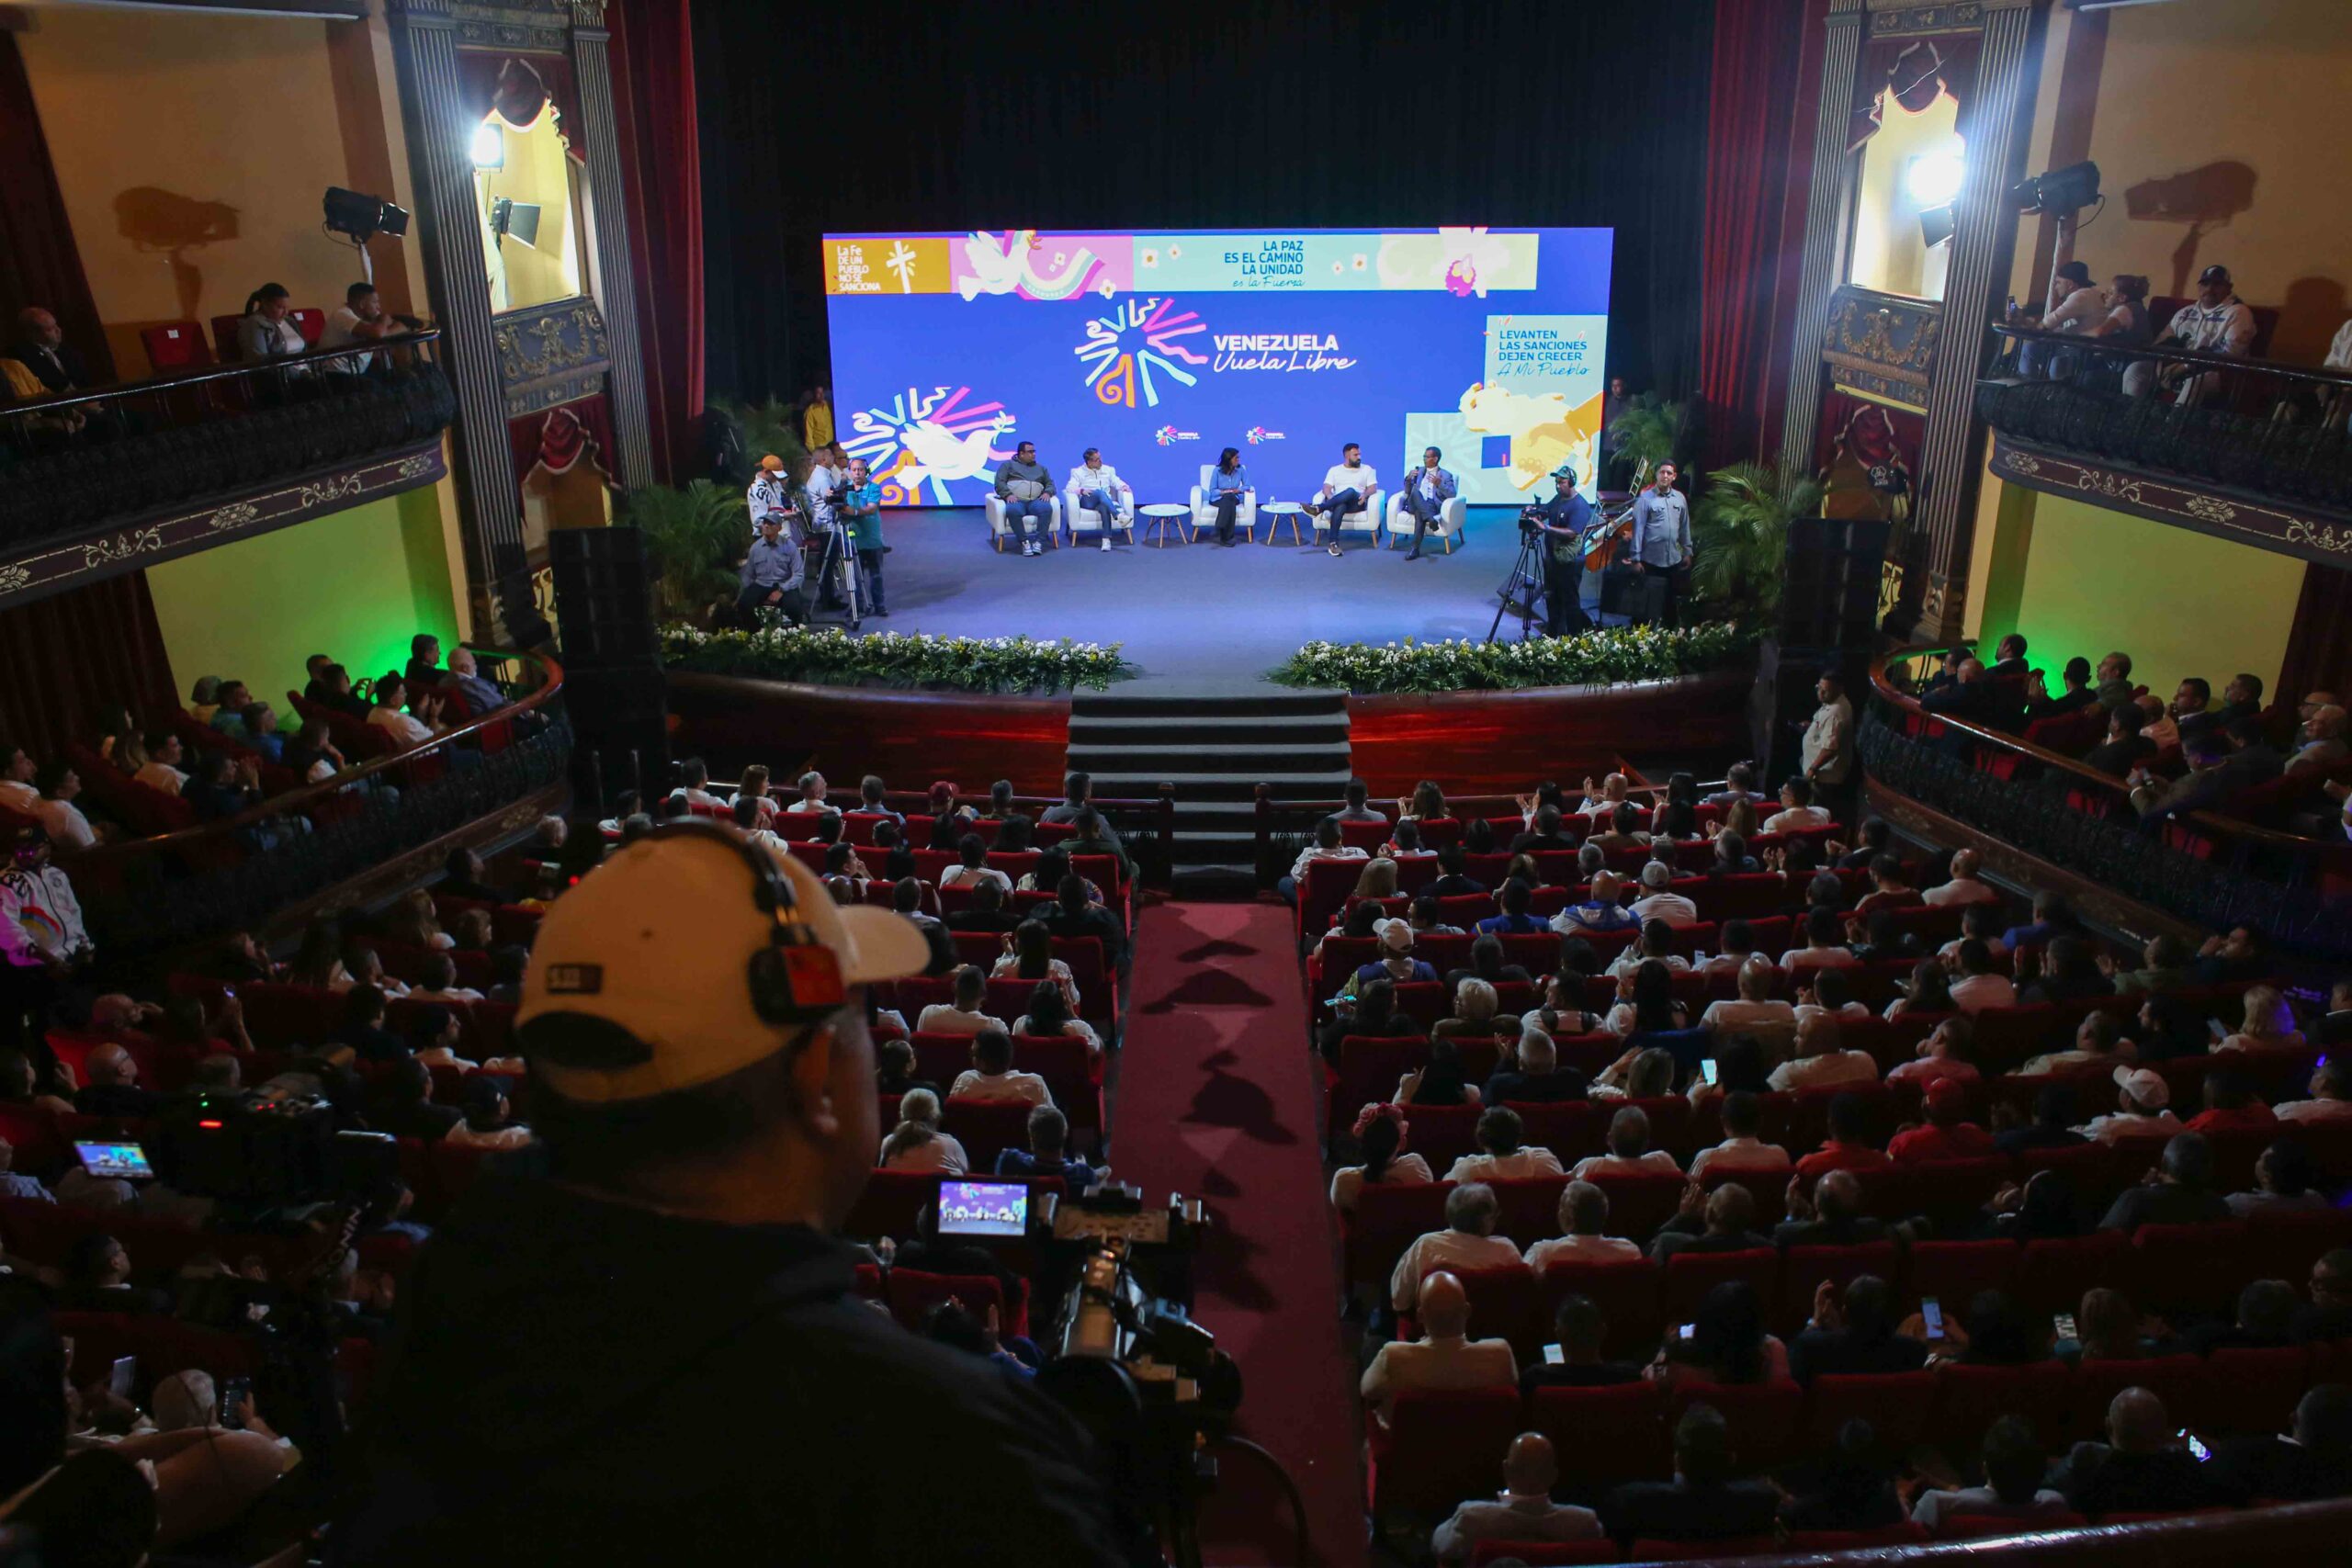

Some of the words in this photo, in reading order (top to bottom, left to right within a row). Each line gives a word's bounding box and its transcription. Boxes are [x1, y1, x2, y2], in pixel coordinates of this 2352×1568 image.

[1263, 241, 1278, 251] LA
[1281, 241, 1304, 251] PAZ
[838, 256, 850, 265] DE
[850, 256, 863, 265] UN
[1224, 253, 1239, 263] ES
[1242, 253, 1256, 263] EL
[1259, 252, 1304, 263] CAMINO
[838, 265, 870, 274] PUEBLO
[1242, 265, 1257, 275] LA
[1260, 264, 1304, 275] UNIDAD
[839, 274, 852, 282] NO
[853, 274, 863, 283] SE
[1249, 276, 1261, 288] la
[839, 282, 882, 292] SANCIONA
[1499, 331, 1558, 339] LEVANTEN
[1213, 334, 1340, 351] VENEZUELA
[1499, 342, 1521, 350] LAS
[1523, 341, 1588, 350] SANCIONES
[1498, 352, 1534, 361] DEJEN
[1537, 352, 1582, 361] CRECER
[1213, 351, 1286, 373] Vuela
[1286, 351, 1358, 373] Libre
[1497, 362, 1512, 377] A
[1537, 362, 1590, 377] Pueblo
